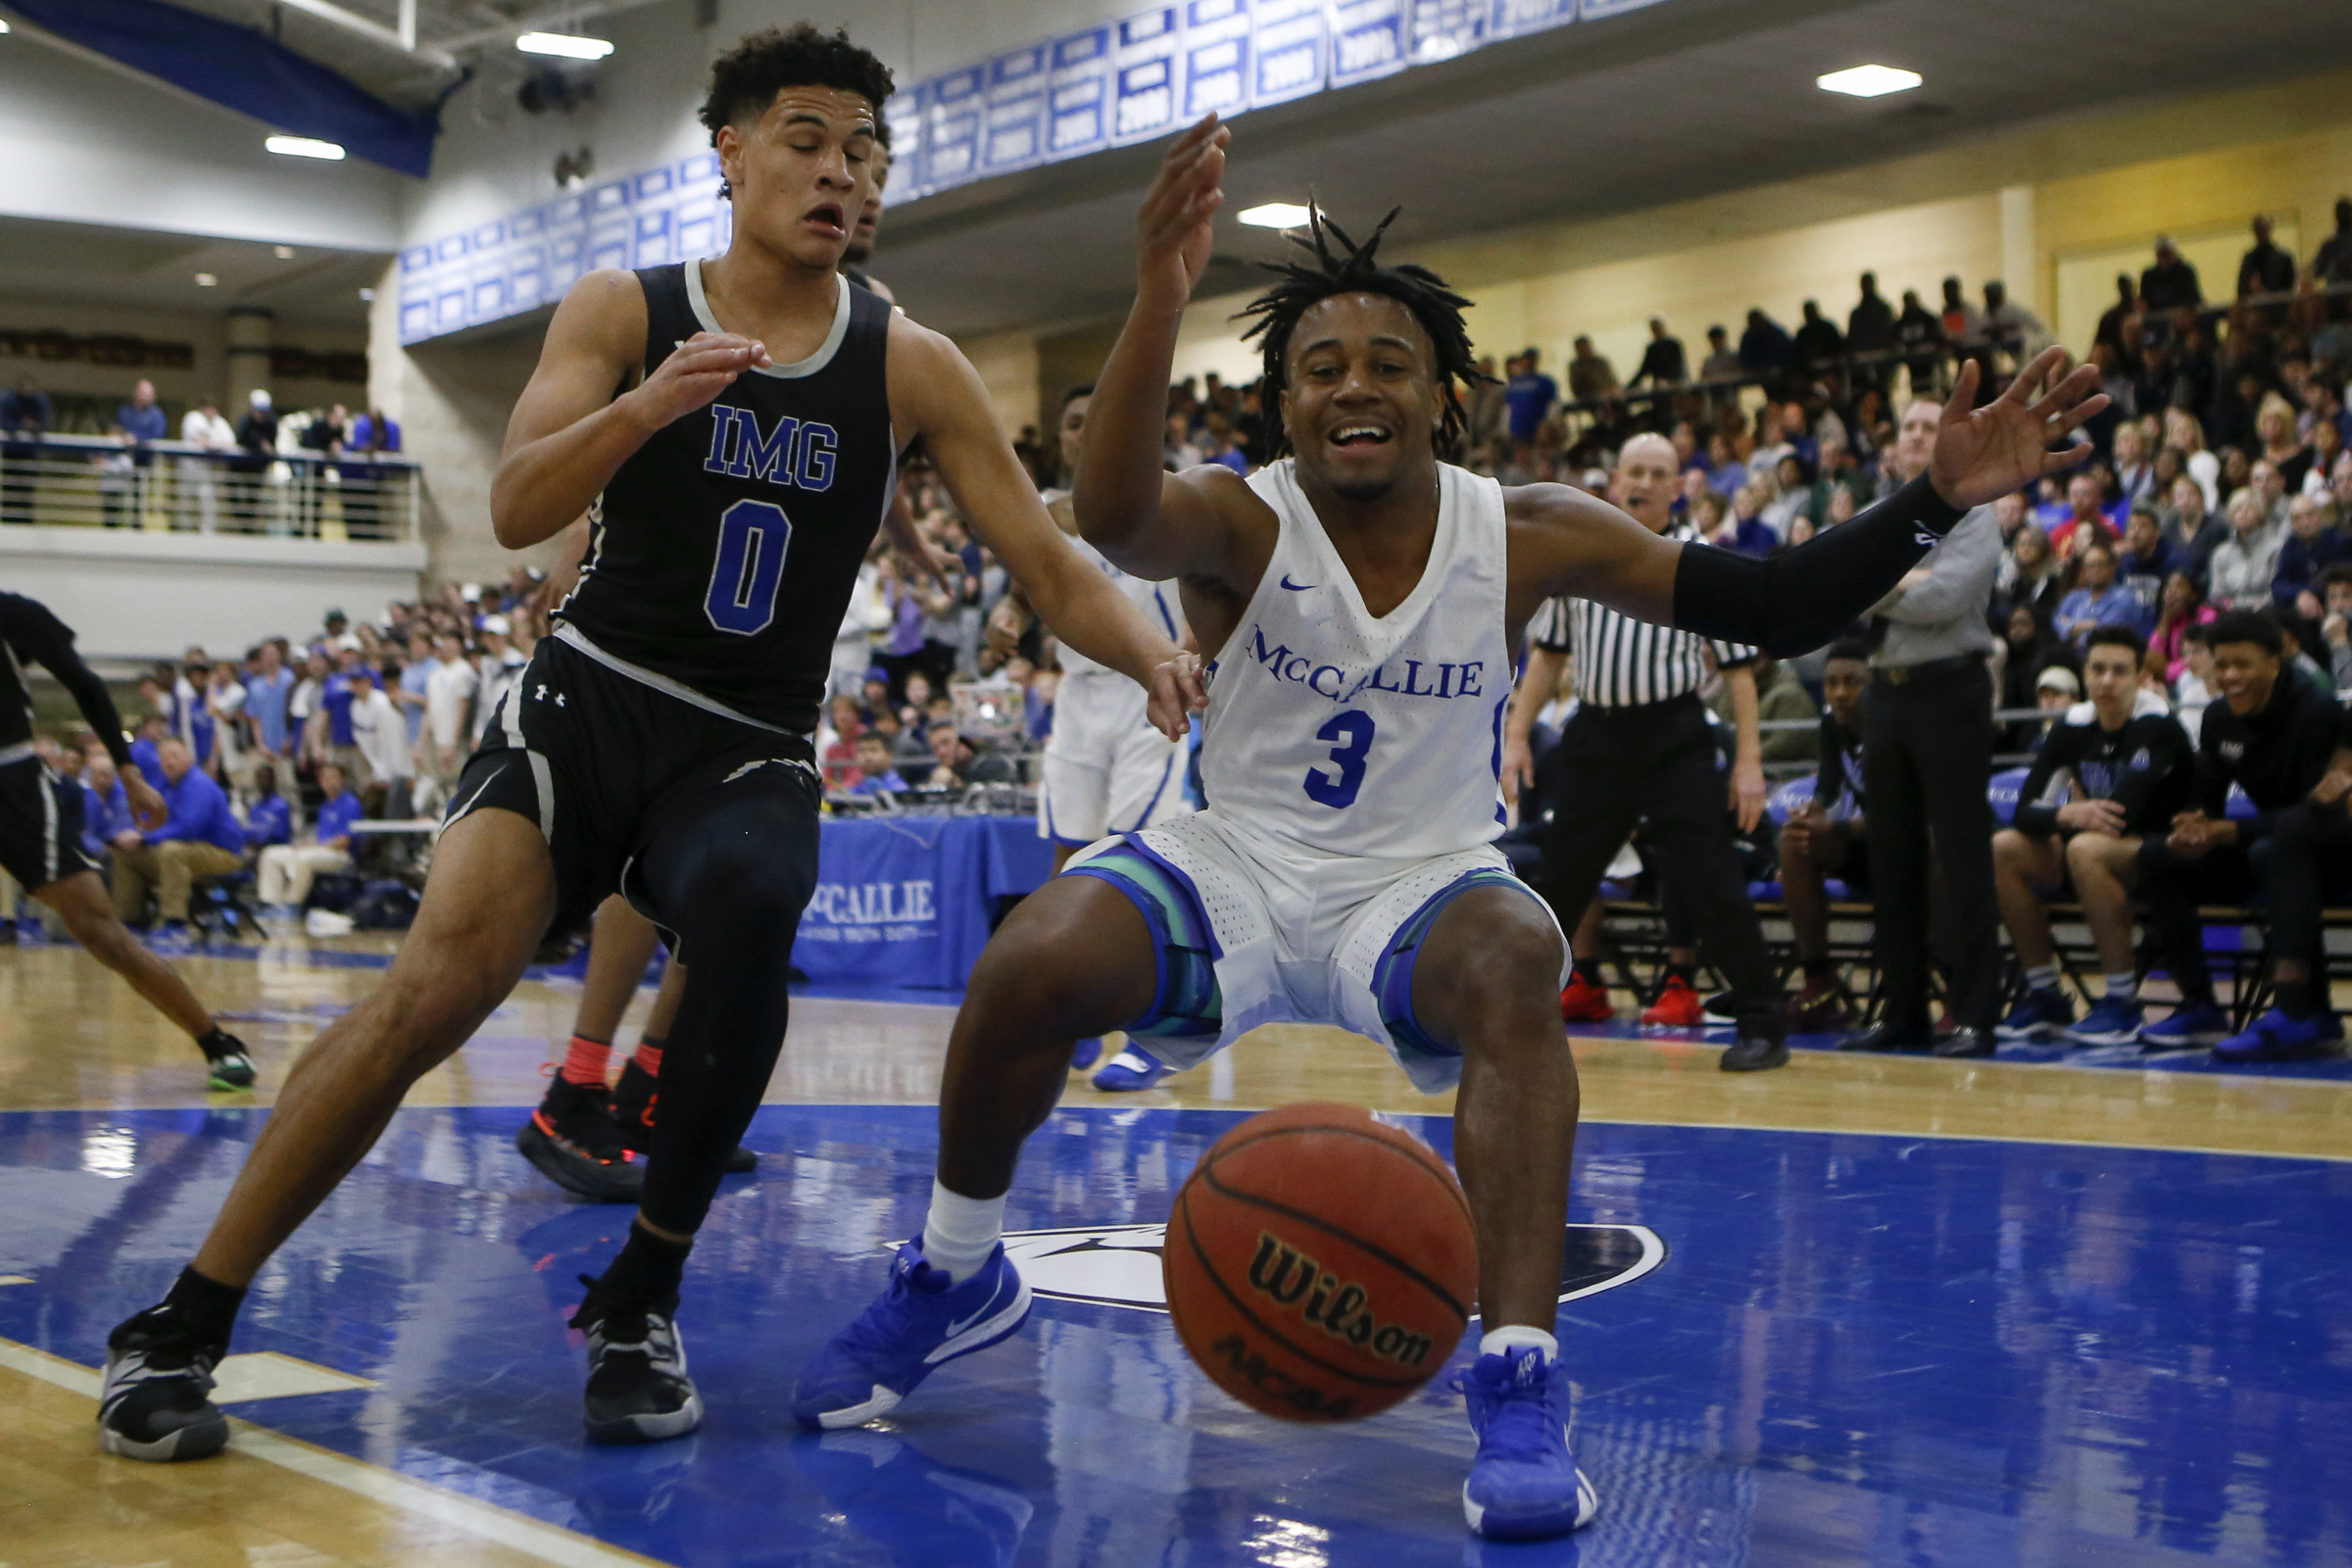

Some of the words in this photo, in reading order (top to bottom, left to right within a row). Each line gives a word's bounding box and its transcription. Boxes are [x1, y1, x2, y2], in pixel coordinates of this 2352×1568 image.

[704, 404, 838, 492] IMG
[703, 498, 793, 636] 0
[1302, 710, 1375, 809] 3
[1249, 1230, 1433, 1366] Wilson
